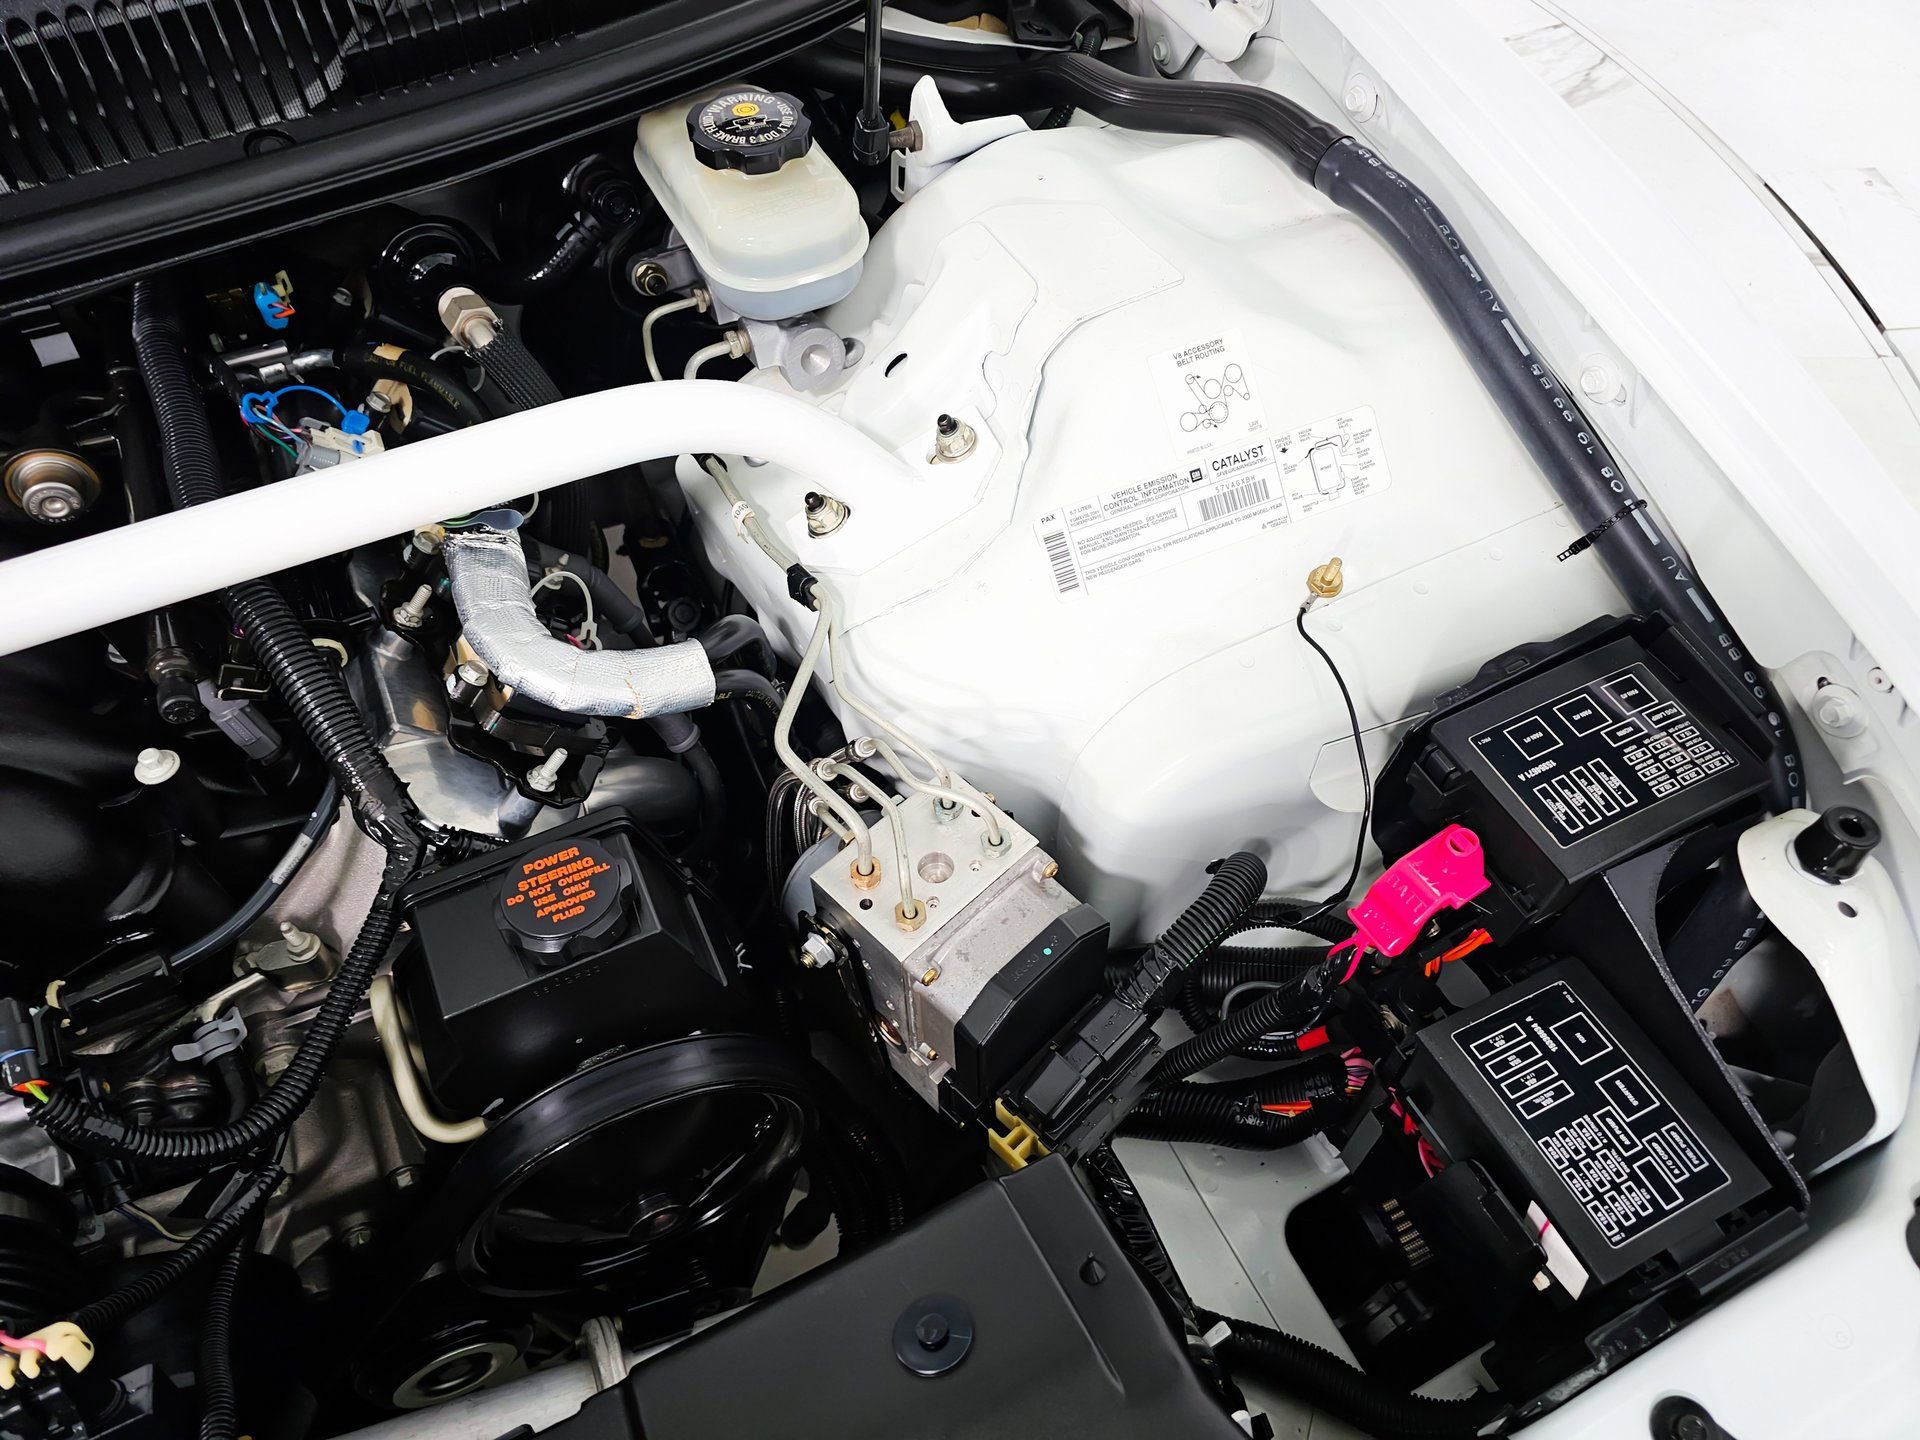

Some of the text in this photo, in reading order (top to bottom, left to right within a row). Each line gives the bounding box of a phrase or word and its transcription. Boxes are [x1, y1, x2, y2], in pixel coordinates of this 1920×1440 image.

[708, 93, 776, 114] WARNING
[778, 103, 793, 115] USE
[702, 114, 715, 133] FLUID
[781, 115, 794, 133] ONLY
[713, 130, 746, 144] BRAKE
[1172, 337, 1223, 360] V8 ACCESSORY
[1176, 344, 1225, 367] BELT ROUTING
[1274, 434, 1291, 444] FRONT
[1577, 430, 1595, 454] 19
[1210, 444, 1266, 471] CATALYST
[1102, 476, 1190, 511] CONTROL INFORMATION
[1111, 472, 1177, 500] VEHICLE EMISSION
[1133, 496, 1154, 507] MOTORS
[1154, 484, 1189, 500] CORPORATION
[1040, 513, 1055, 523] PAX
[1077, 503, 1091, 512] LITER
[1078, 540, 1100, 550] MANUAL
[1113, 522, 1150, 538] MAINTENANCE
[1150, 512, 1178, 525] SCHEDULE
[1085, 526, 1121, 542] ADJUSTMENTS
[1155, 507, 1176, 518] SERVICE
[1091, 543, 1106, 551] MORE
[1096, 561, 1116, 571] VEHICLE
[1117, 550, 1145, 564] CONFORMS
[1204, 519, 1234, 533] APPLICABLE
[1097, 562, 1128, 576] PASSENGER
[1661, 556, 1689, 583] AU
[1626, 688, 1639, 696] FAN
[1578, 709, 1592, 717] FAN
[1649, 706, 1677, 721] FOG LAMP
[1529, 731, 1543, 740] FAN
[1615, 726, 1634, 736] HORN
[1767, 711, 1785, 739] 19
[1516, 773, 1527, 781] A
[523, 847, 579, 874] POWER
[507, 863, 610, 906] DO NOT OVERFILL
[518, 857, 594, 891] STEERING
[533, 880, 590, 907] USE ONLY
[537, 890, 596, 918] APPROVED
[552, 905, 585, 923] FLUID
[1574, 1031, 1587, 1043] IGN
[1614, 1078, 1639, 1106] STARTER
[1604, 1116, 1631, 1145] AIR PUMP
[1650, 1140, 1669, 1160] COMP
[1669, 1129, 1700, 1164] FUEL PUMP
